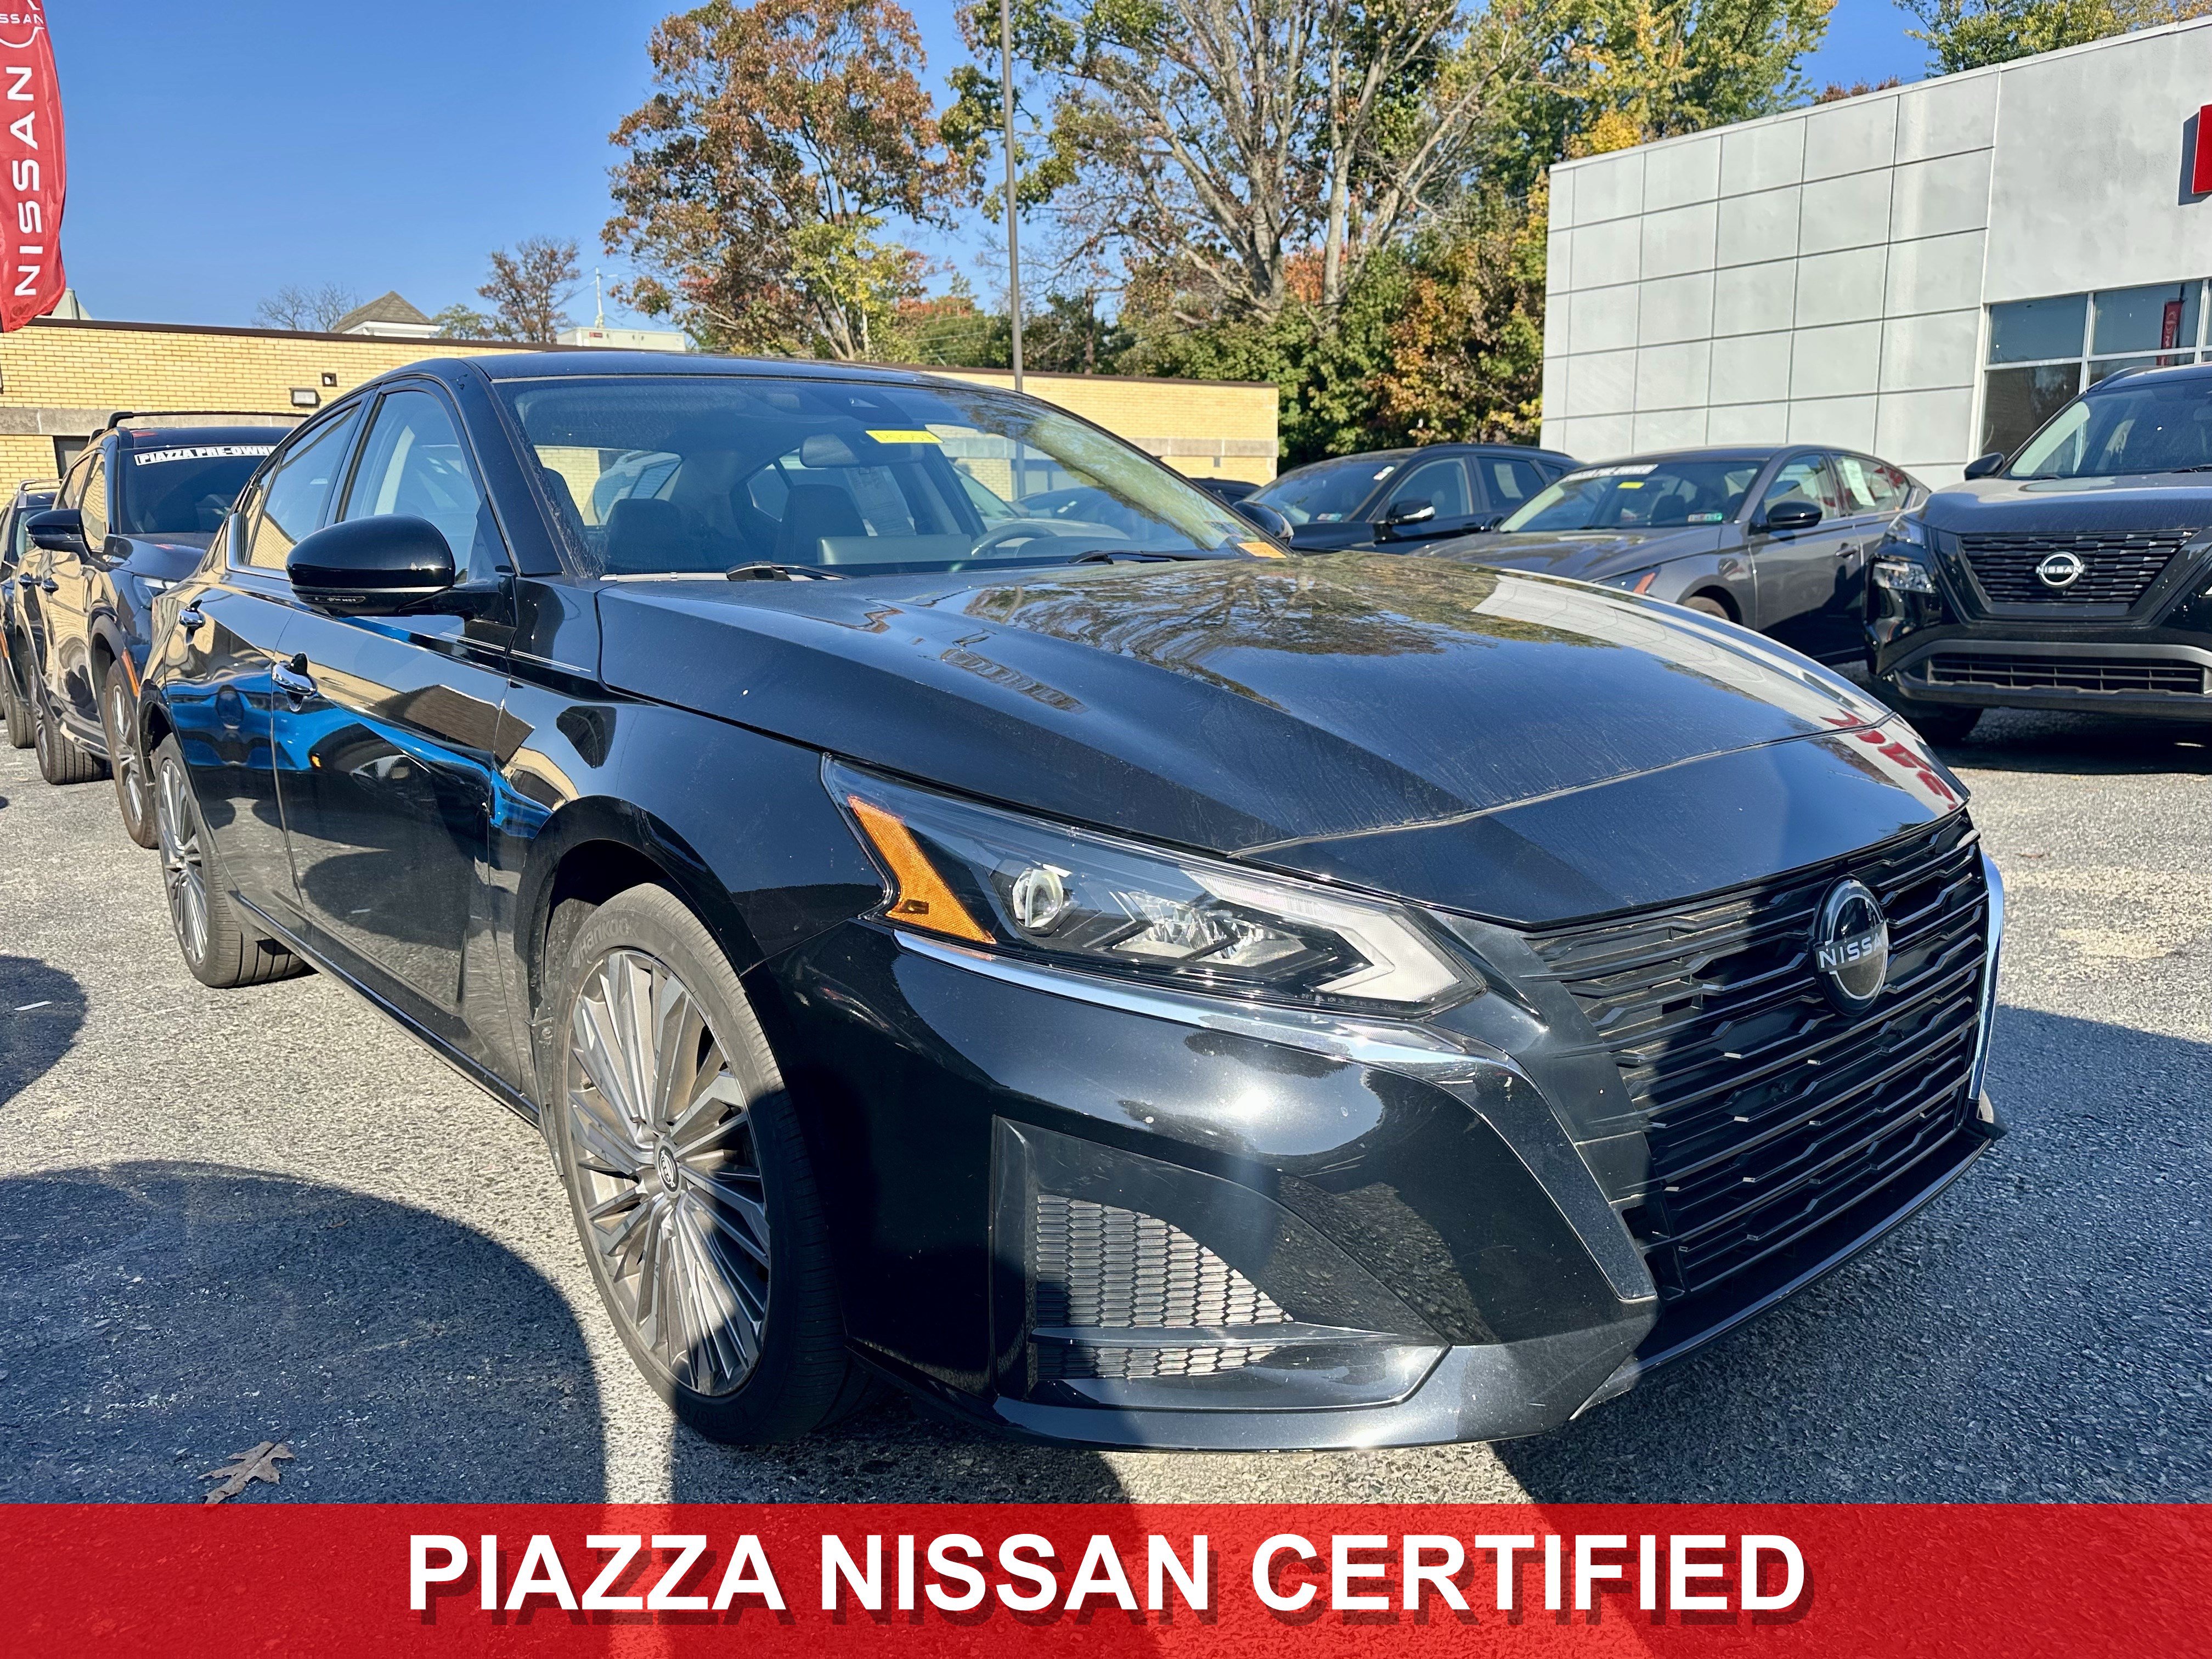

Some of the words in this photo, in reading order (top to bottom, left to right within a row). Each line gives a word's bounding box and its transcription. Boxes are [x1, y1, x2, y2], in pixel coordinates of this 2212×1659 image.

[6, 66, 43, 296] NISSAN
[139, 449, 196, 464] PIAZZA
[2036, 565, 2084, 573] NISSAN
